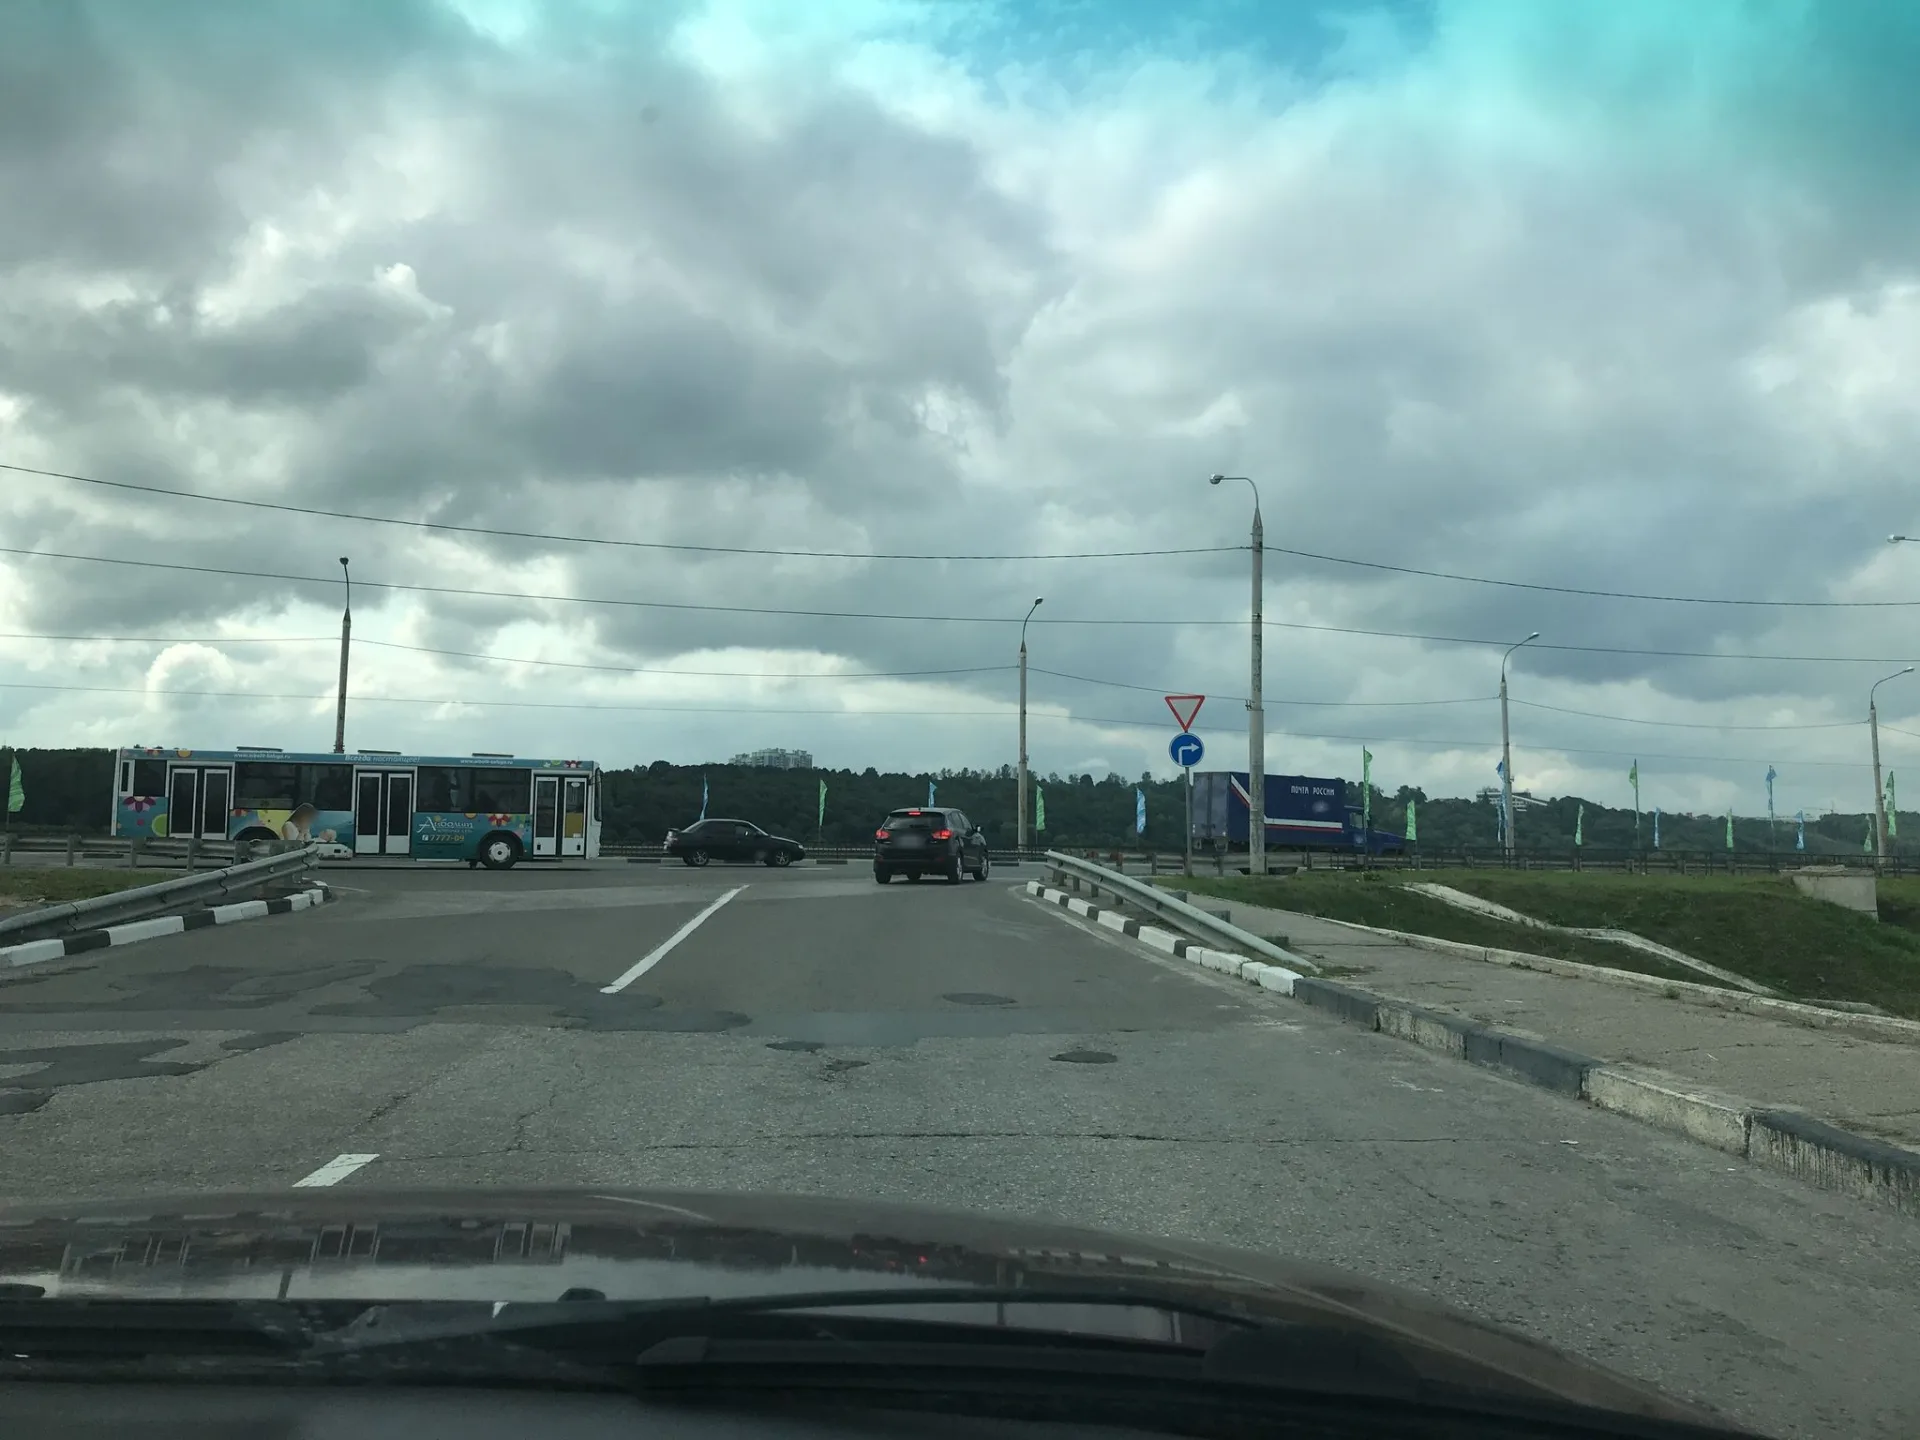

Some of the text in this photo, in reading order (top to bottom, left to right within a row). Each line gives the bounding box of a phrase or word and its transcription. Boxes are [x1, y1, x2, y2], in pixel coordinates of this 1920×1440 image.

[1291, 785, 1335, 795] ПОЧТА РОССИИ
[416, 816, 474, 833] Айболит
